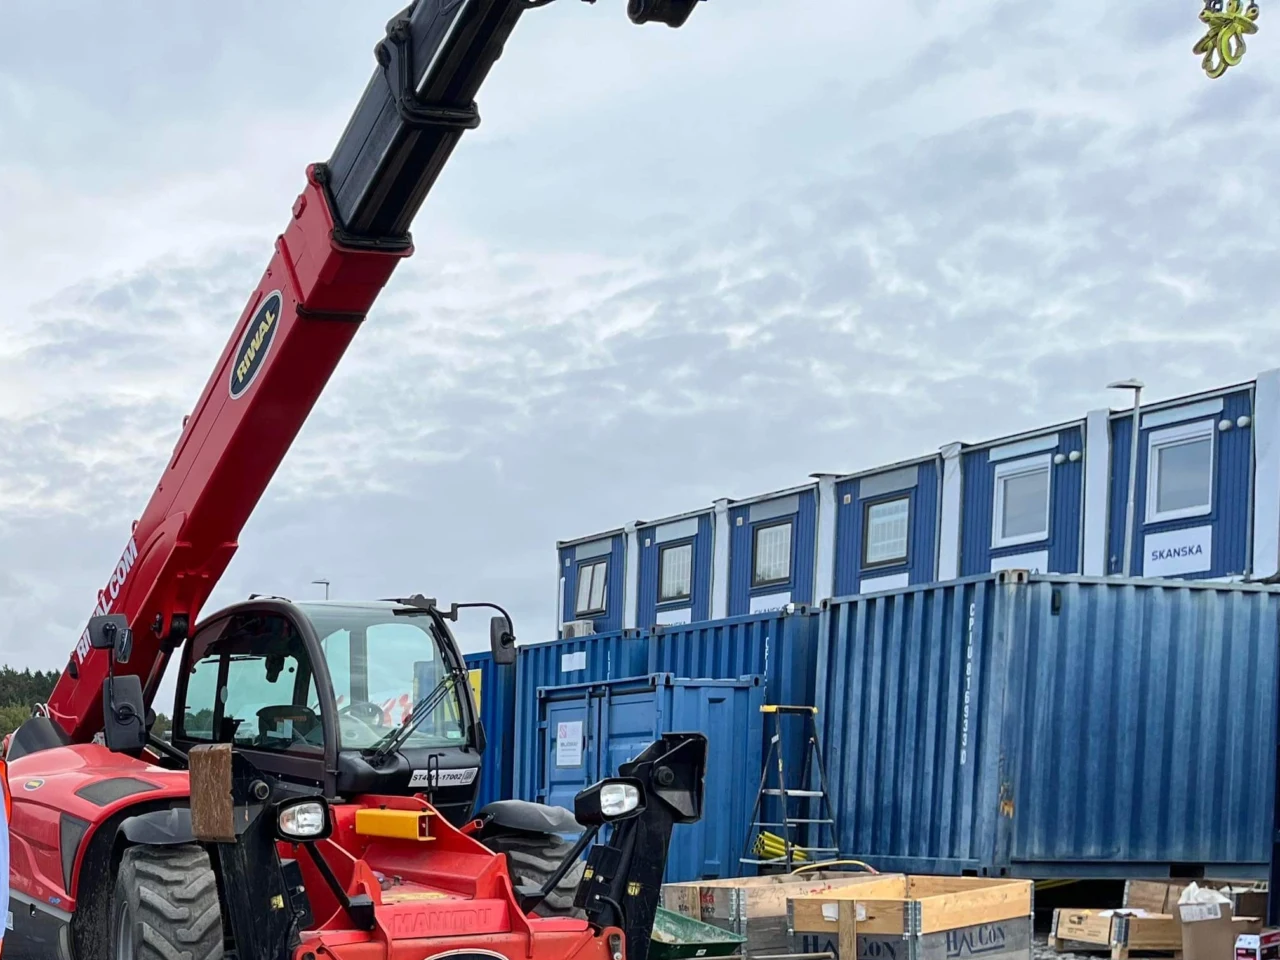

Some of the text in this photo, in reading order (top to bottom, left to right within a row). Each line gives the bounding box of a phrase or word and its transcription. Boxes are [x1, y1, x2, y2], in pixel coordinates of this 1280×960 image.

[236, 310, 275, 383] RIWAL
[1151, 544, 1203, 561] SKANSKA
[390, 907, 492, 934] MANITOU
